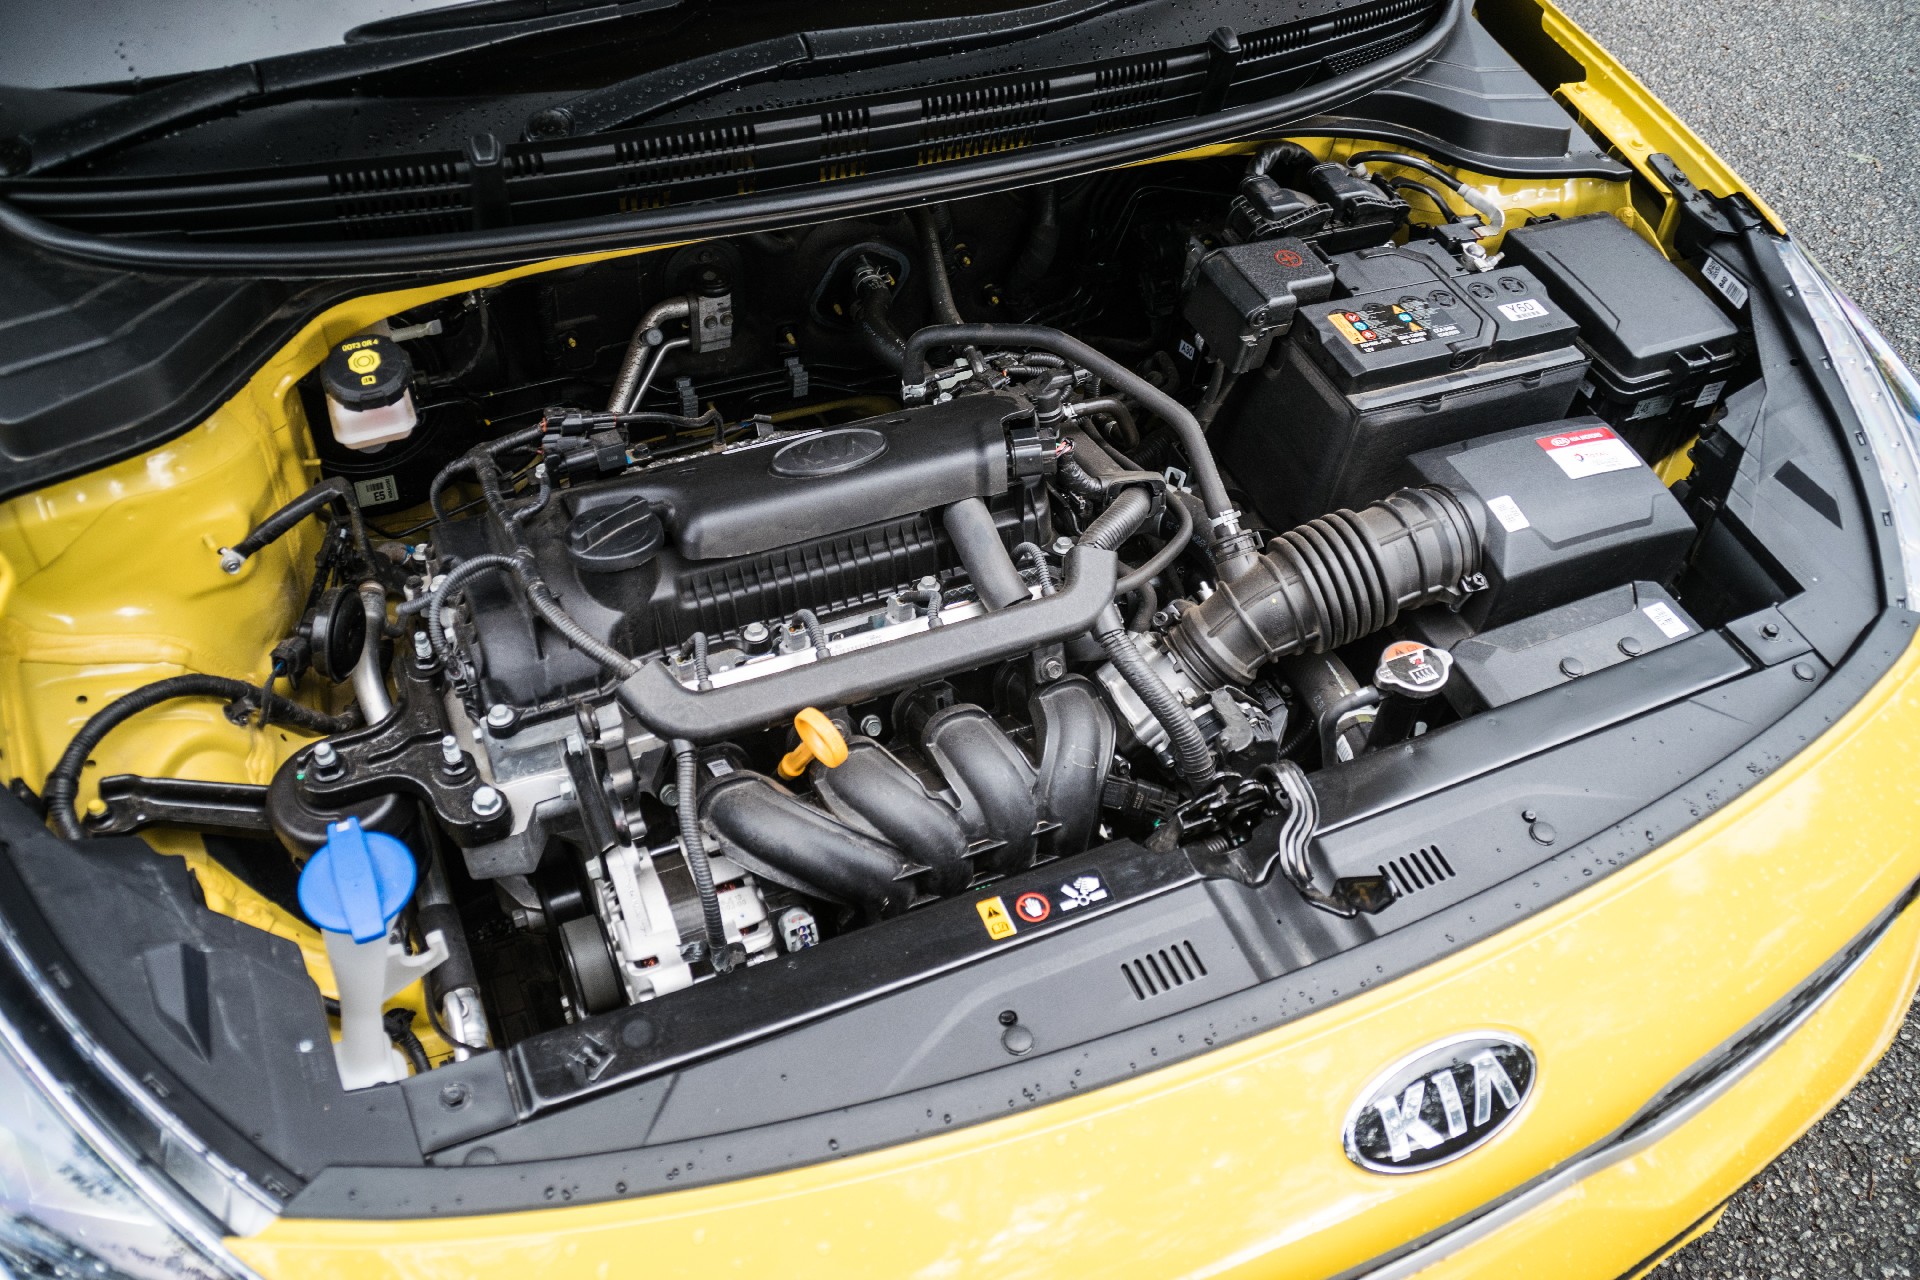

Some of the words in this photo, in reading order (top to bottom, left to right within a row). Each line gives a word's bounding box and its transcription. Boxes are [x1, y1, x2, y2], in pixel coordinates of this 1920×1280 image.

[1505, 302, 1534, 313] Y60
[342, 342, 361, 351] DOT3
[374, 490, 386, 501] E5
[1374, 1049, 1520, 1162] KIA
